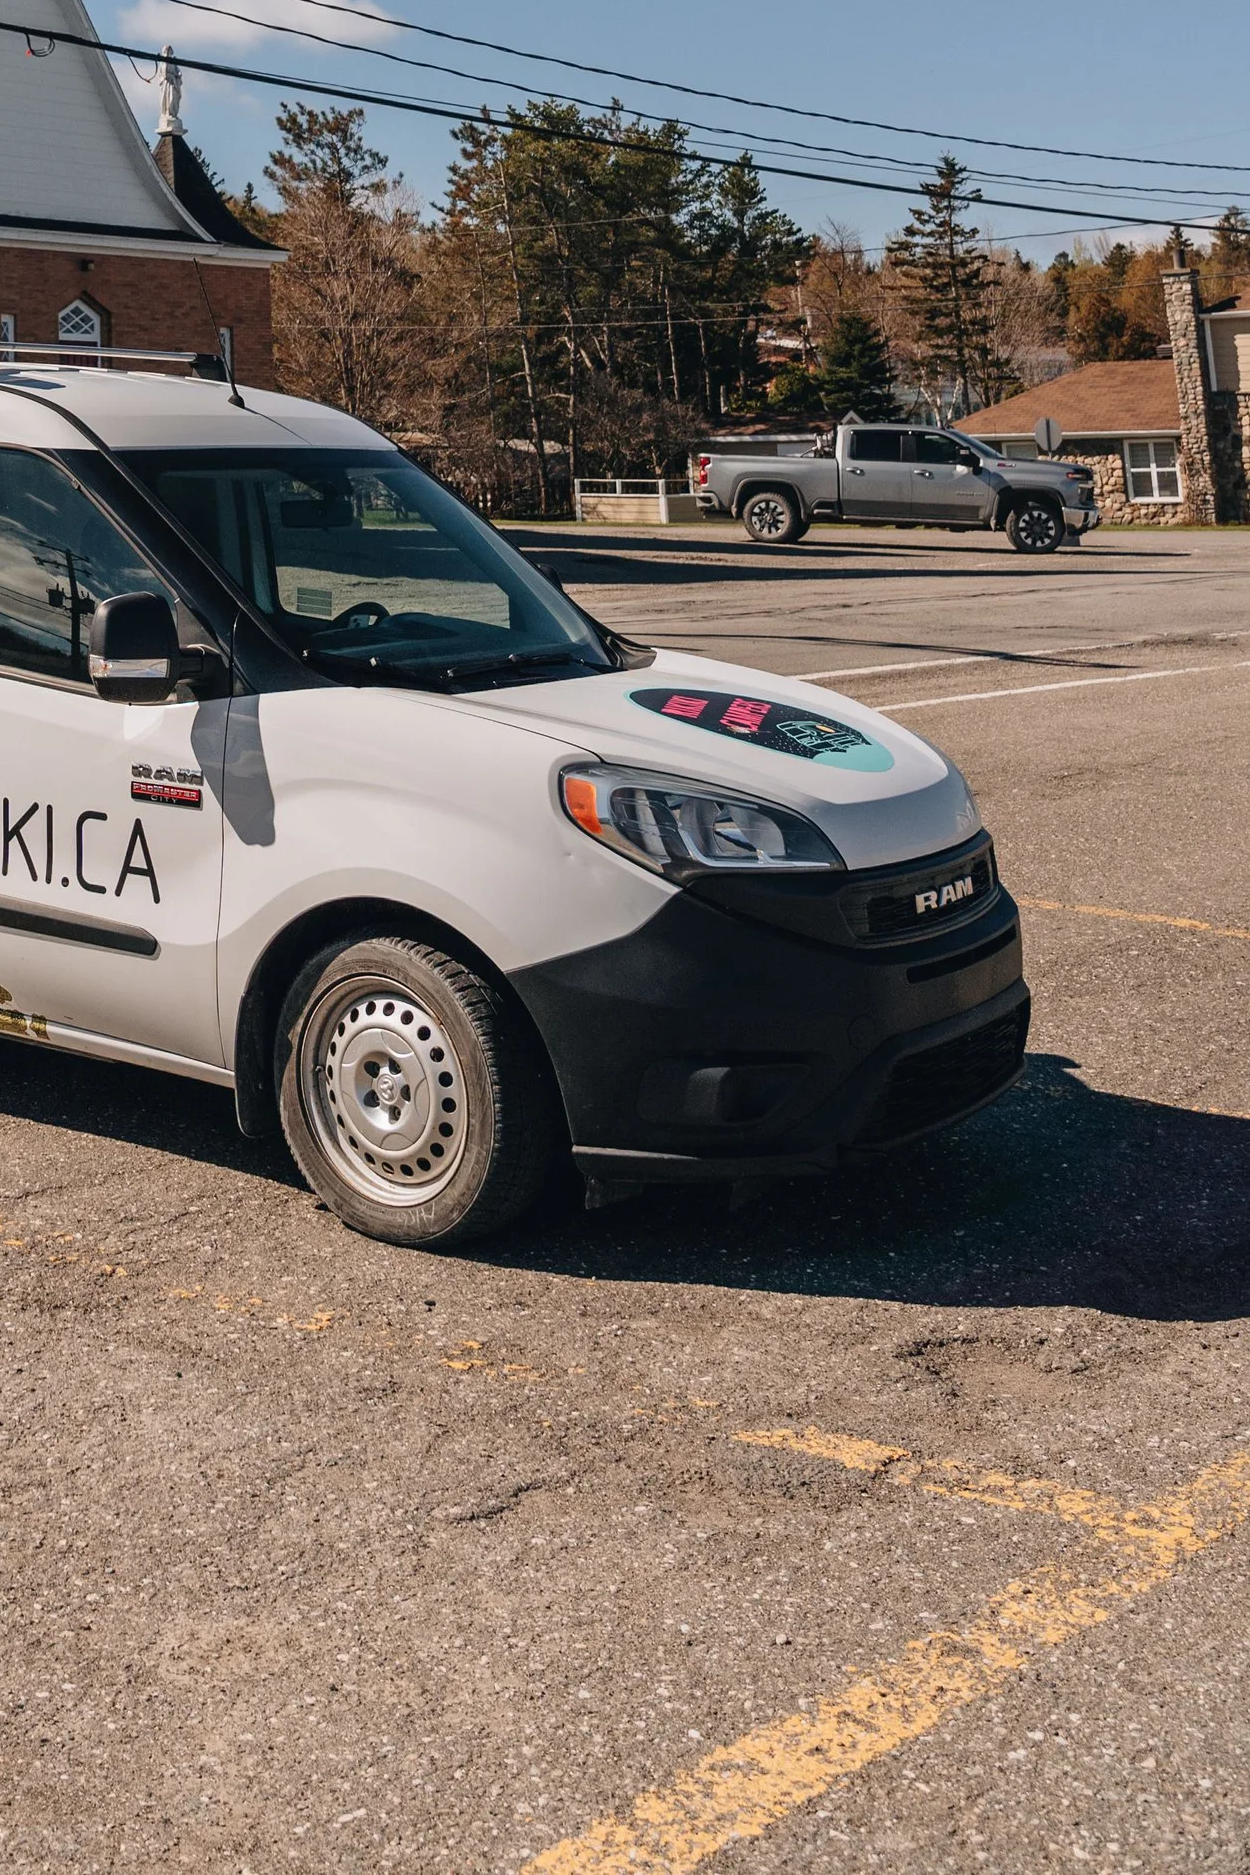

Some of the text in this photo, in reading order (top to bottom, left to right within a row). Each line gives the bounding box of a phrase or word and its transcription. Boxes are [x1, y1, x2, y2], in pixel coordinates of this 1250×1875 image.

[131, 762, 204, 786] RAM
[151, 795, 178, 803] CITY
[915, 876, 974, 914] RAM
